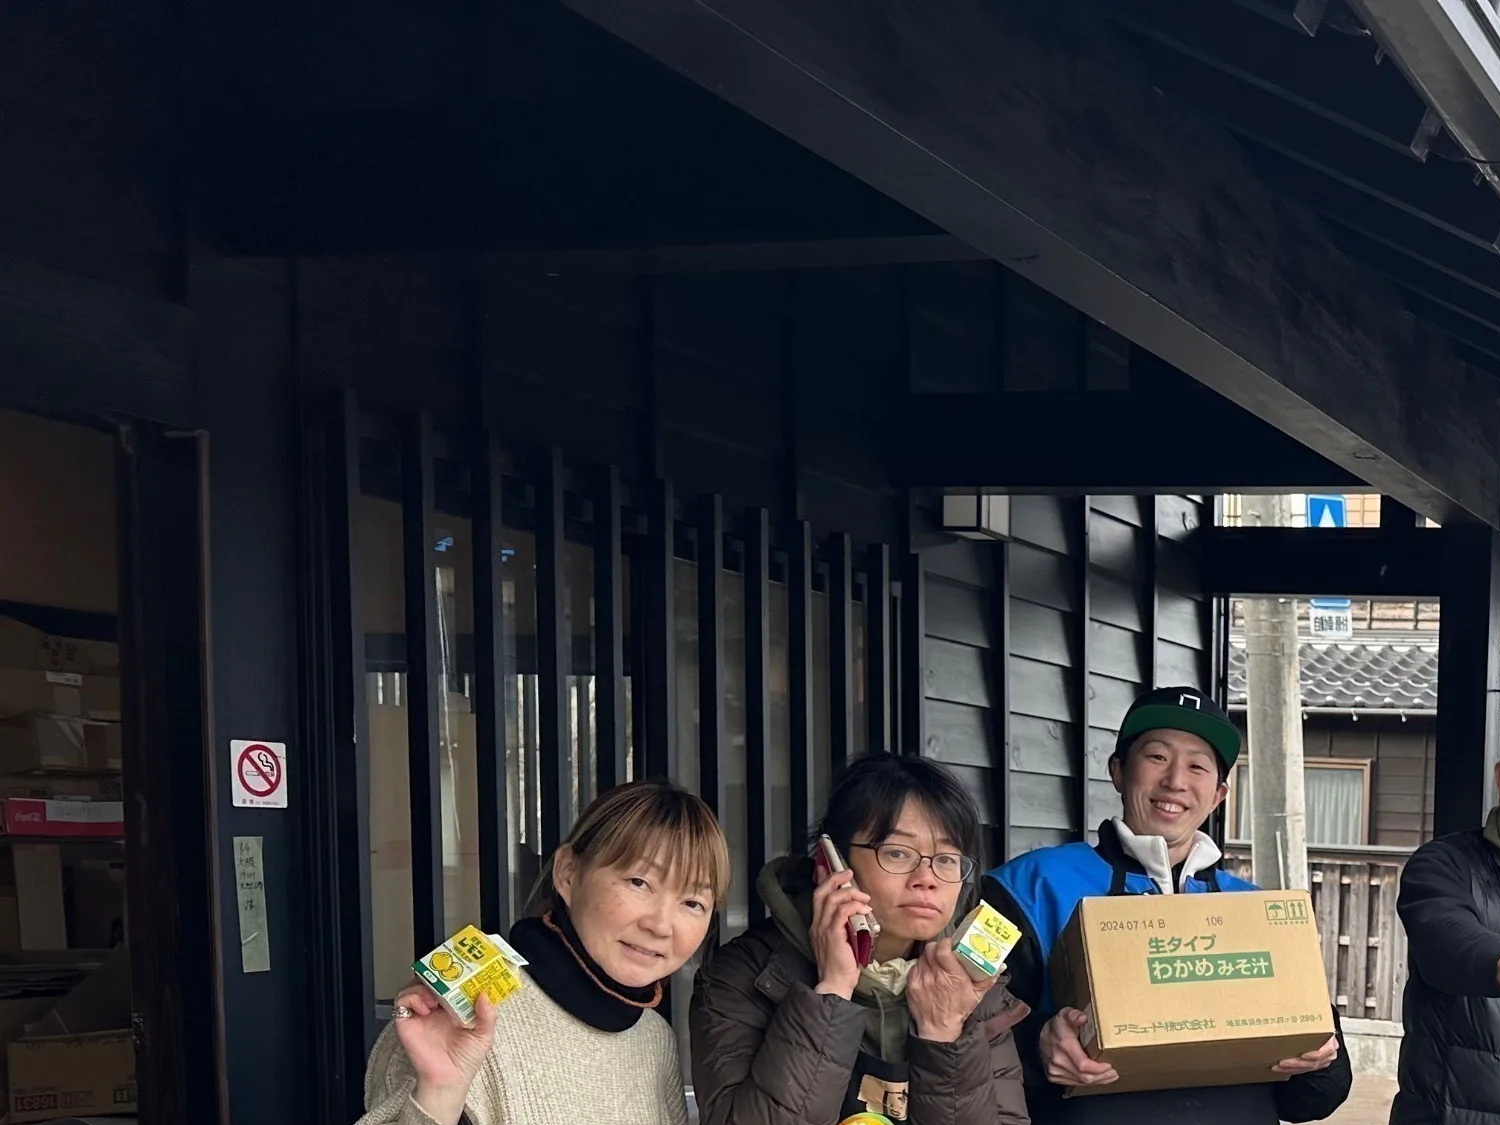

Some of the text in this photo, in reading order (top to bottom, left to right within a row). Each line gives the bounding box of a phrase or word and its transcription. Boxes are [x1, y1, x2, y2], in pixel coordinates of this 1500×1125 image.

[984, 918, 1011, 940] レモン
[1100, 919, 1166, 931] 2024 07 14 B
[1205, 916, 1223, 926] 106
[458, 937, 485, 960] レモン
[1148, 934, 1216, 954] 生タイプ
[1153, 957, 1269, 980] わかめみそ汁
